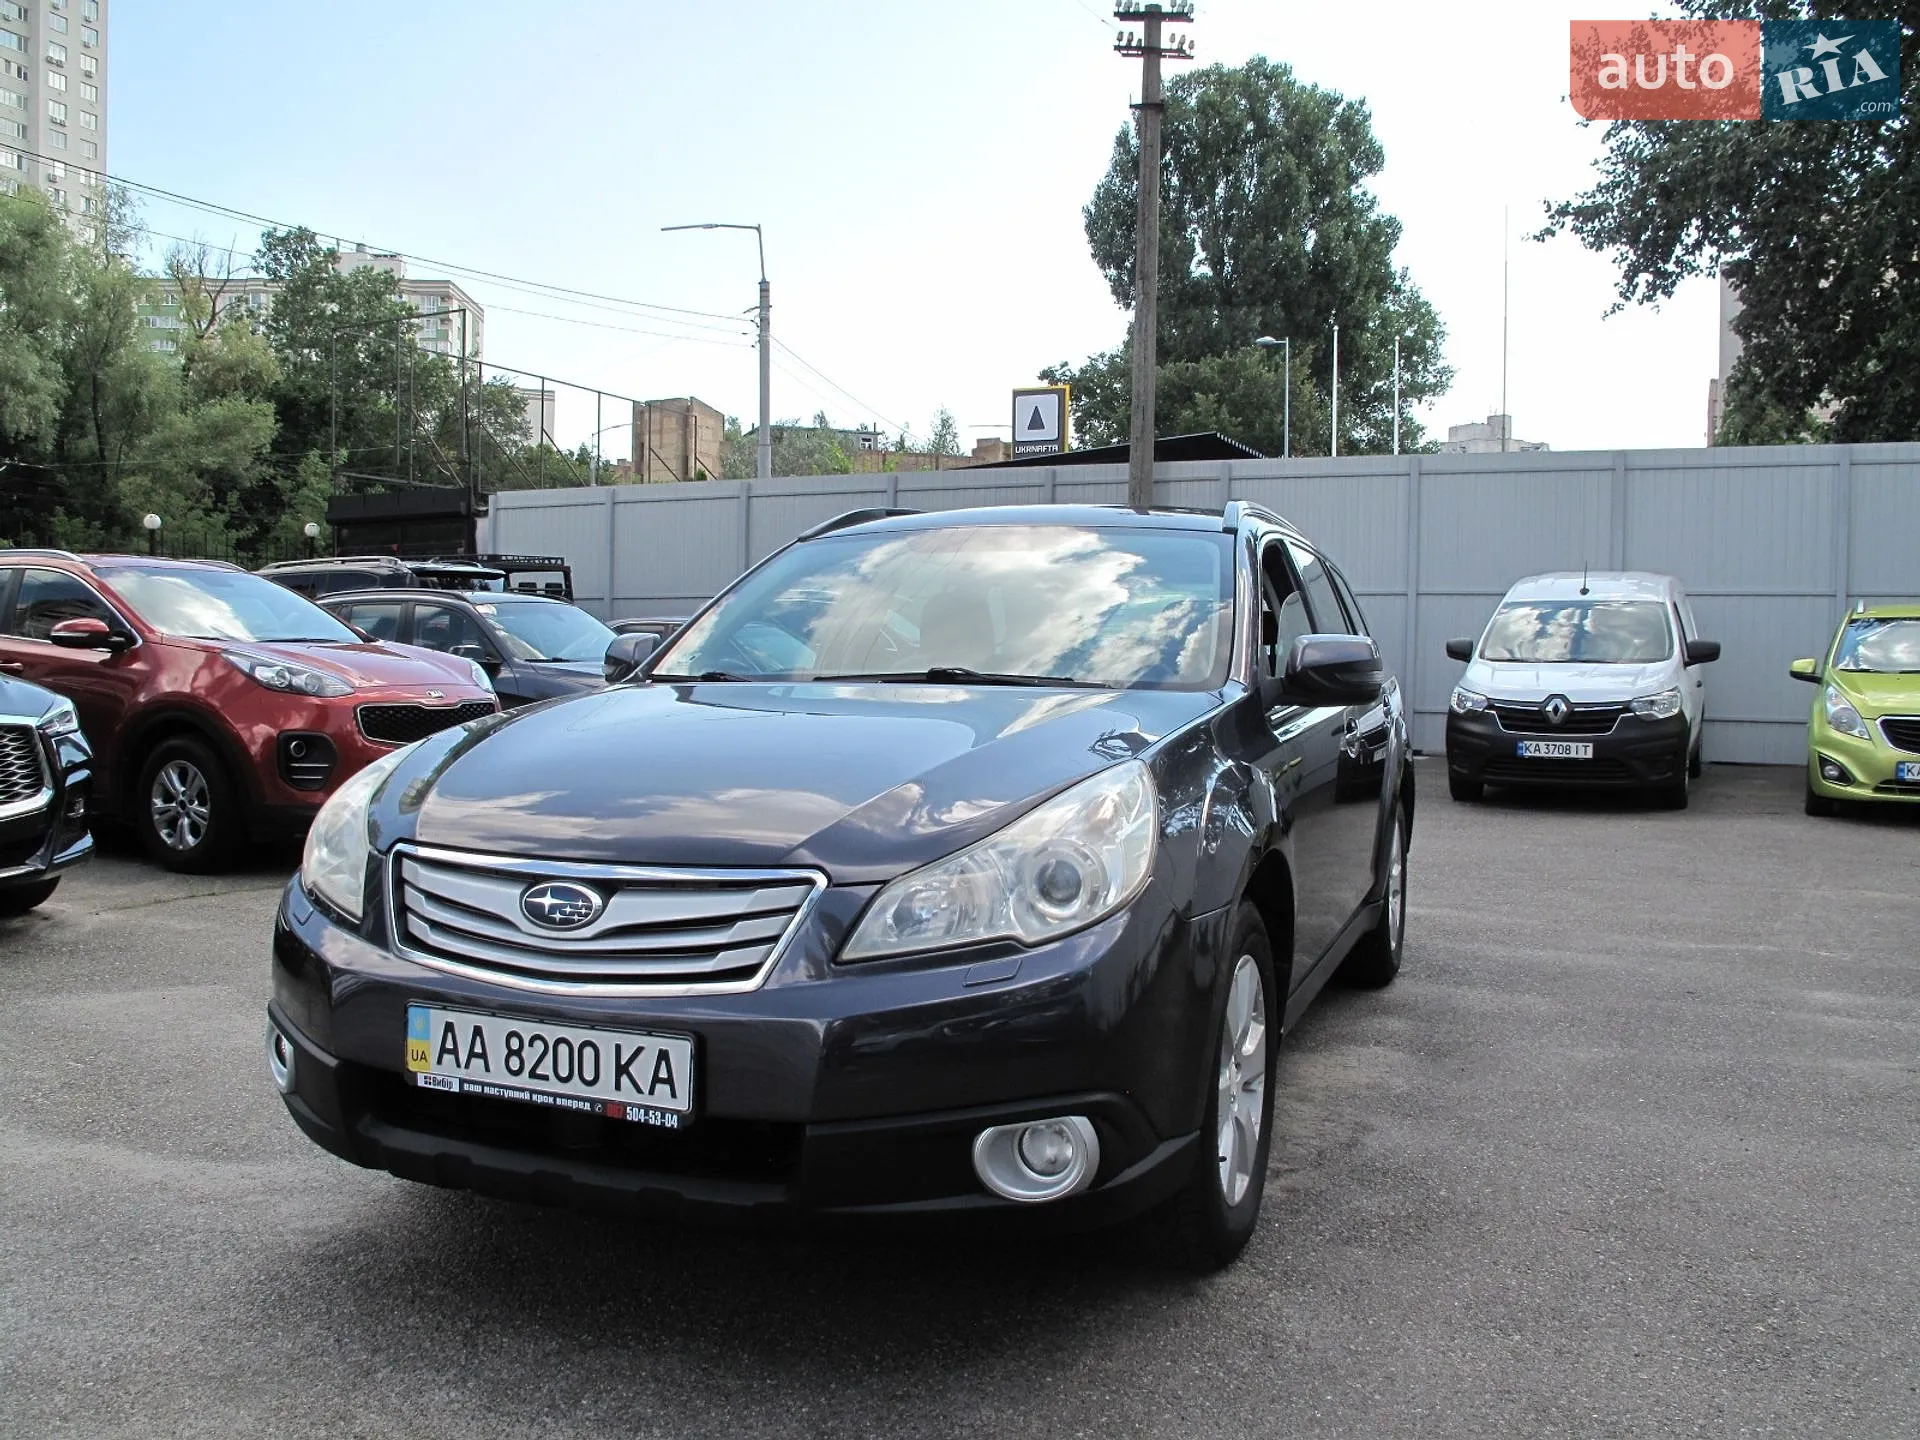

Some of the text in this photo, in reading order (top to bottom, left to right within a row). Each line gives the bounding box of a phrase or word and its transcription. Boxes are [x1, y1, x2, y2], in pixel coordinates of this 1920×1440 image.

[1015, 444, 1059, 454] UKRNAFTA
[1524, 743, 1541, 754] KA
[1543, 743, 1571, 755] 3708
[411, 1050, 428, 1063] UA
[436, 1020, 678, 1099] AA 8200 KA
[626, 1106, 678, 1129] 504-53-04
